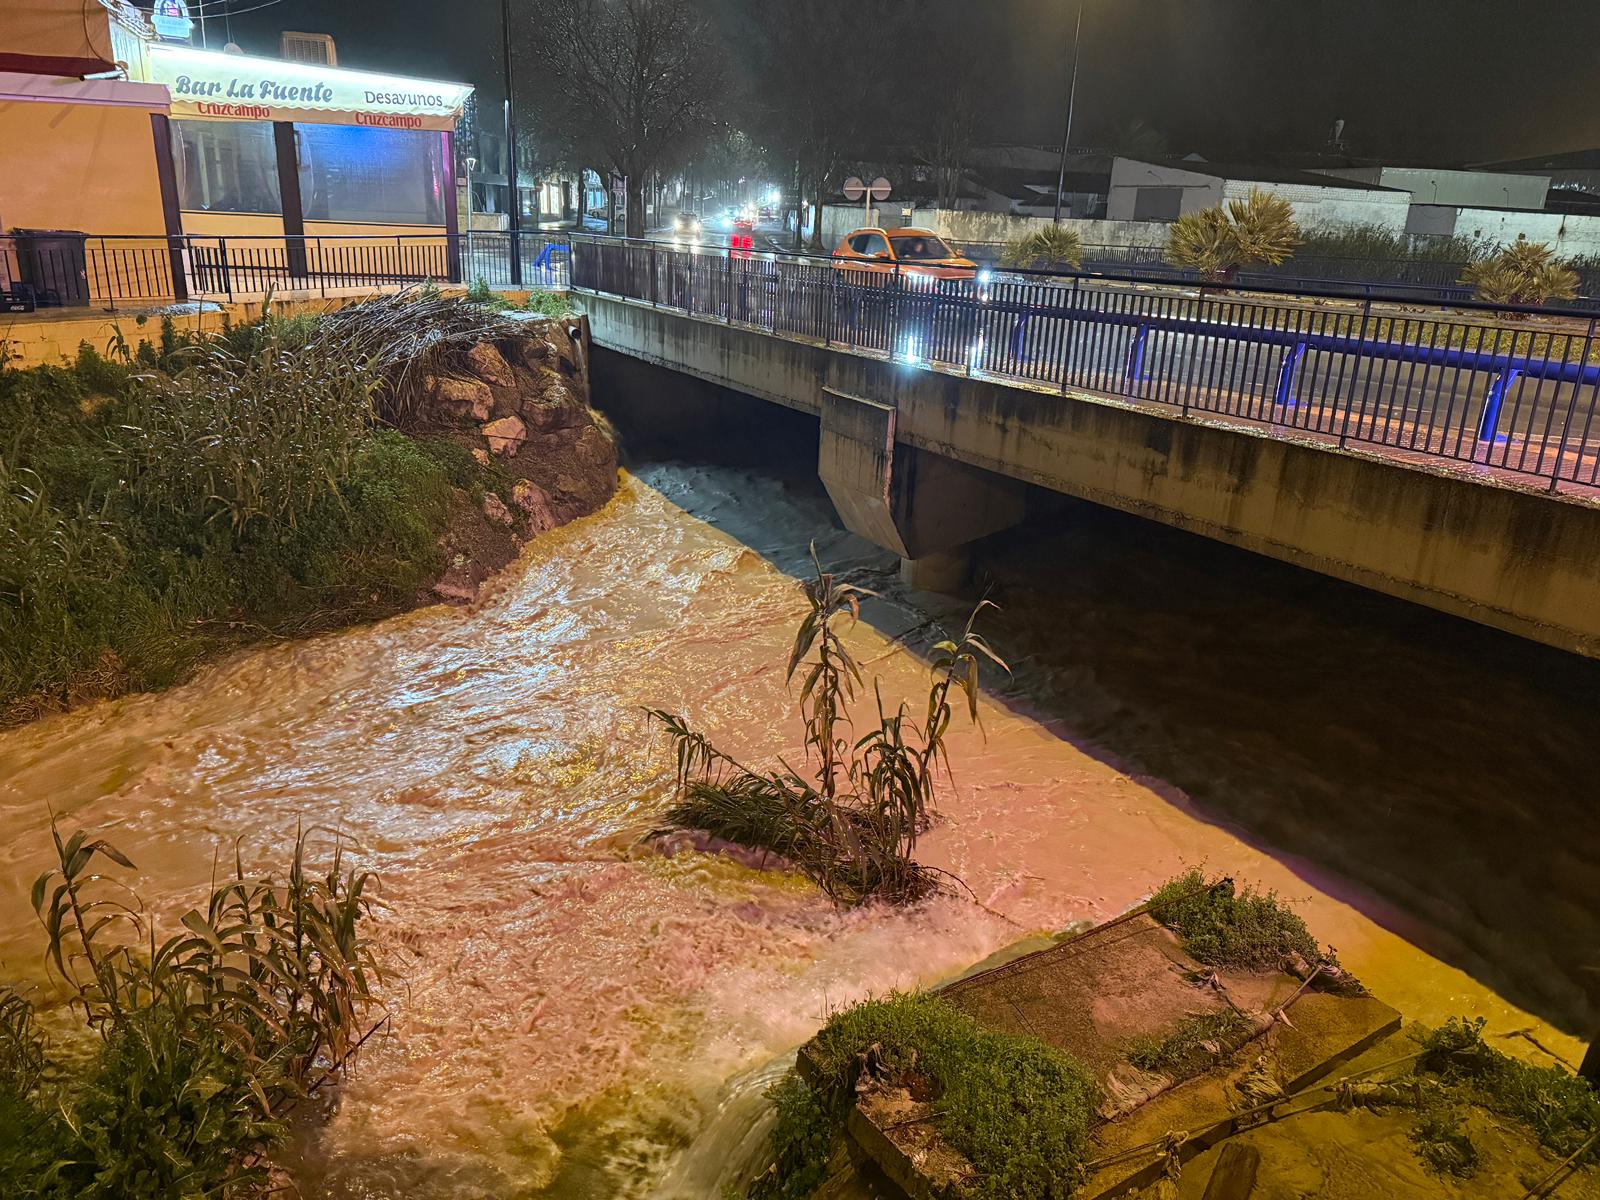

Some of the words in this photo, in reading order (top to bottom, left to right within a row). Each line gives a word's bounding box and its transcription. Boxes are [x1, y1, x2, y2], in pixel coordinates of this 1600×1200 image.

[175, 75, 222, 96] Bar
[226, 79, 255, 99] La
[260, 80, 333, 103] Fuente
[364, 91, 443, 107] Desayunos
[197, 102, 270, 119] Cruzcampo
[355, 112, 422, 129] Cruzcampo
